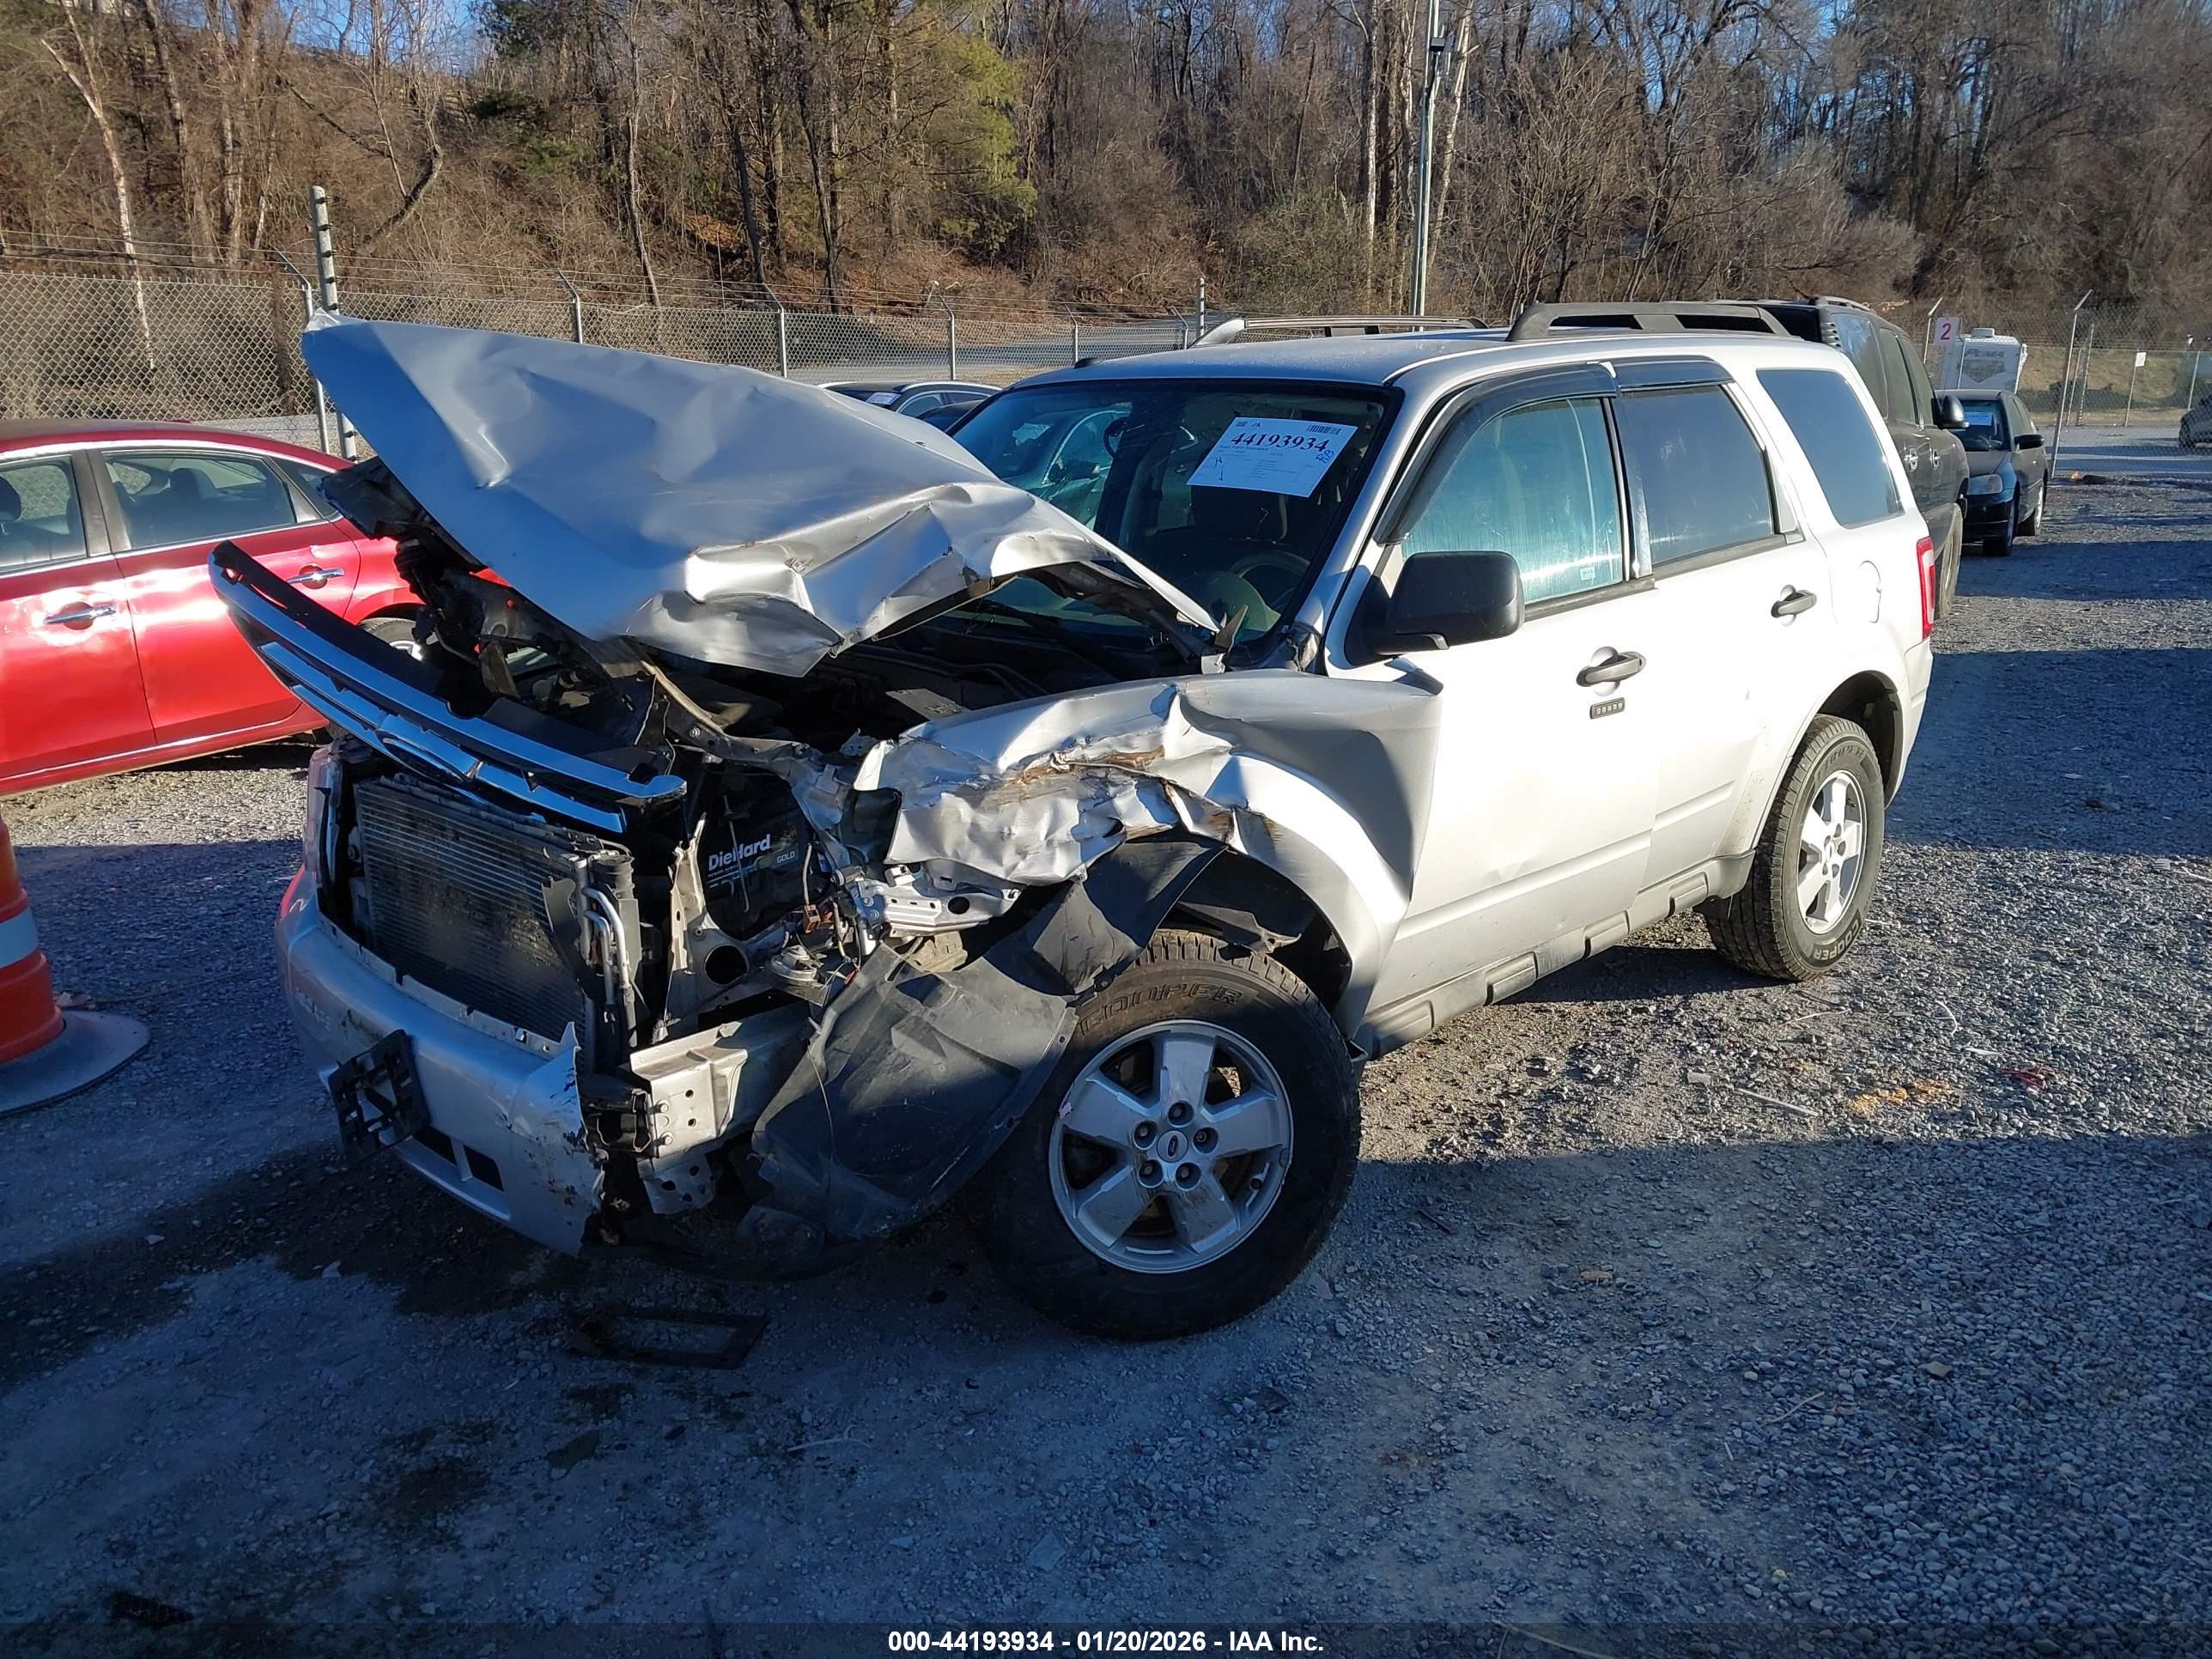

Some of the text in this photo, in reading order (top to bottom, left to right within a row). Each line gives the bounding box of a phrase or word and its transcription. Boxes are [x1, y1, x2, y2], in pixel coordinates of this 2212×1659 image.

[1940, 323, 1952, 340] 2
[1231, 433, 1330, 453] 44193934
[708, 833, 771, 871] DieHard
[776, 851, 795, 864] GOLD
[1814, 919, 1859, 961] COOPER
[1079, 981, 1243, 1036] COOPER
